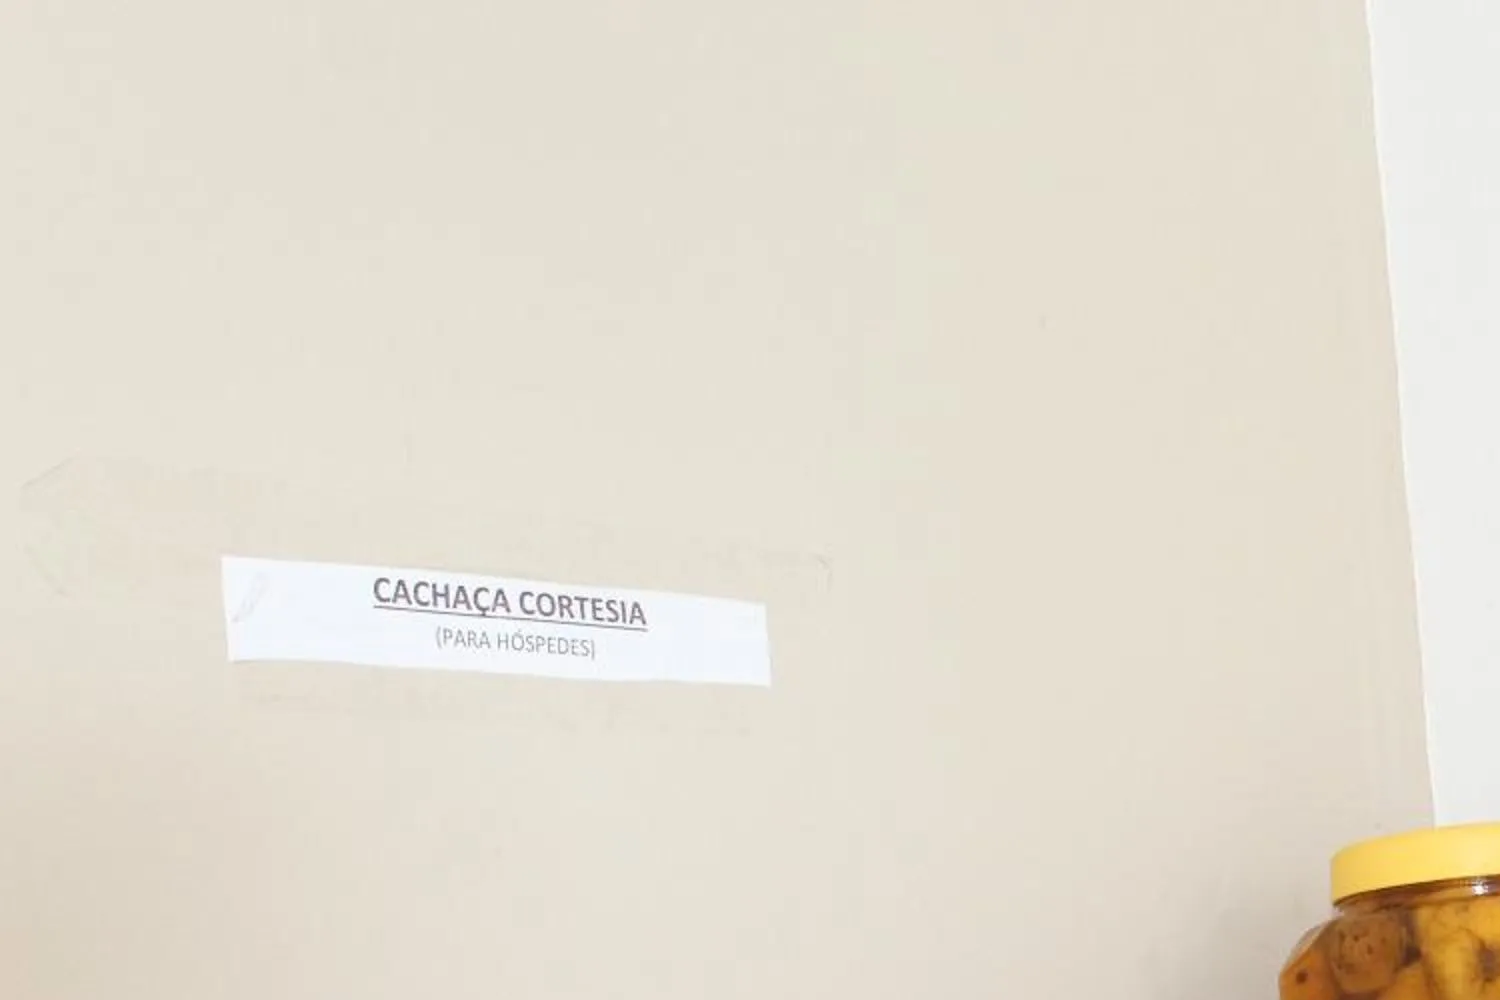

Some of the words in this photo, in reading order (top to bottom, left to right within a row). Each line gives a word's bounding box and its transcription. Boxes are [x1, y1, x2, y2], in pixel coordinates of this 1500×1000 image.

[373, 577, 511, 616] CACHAÇA
[519, 591, 647, 626] CORTESIA
[436, 627, 491, 651] (PARA
[497, 629, 596, 660] HÓSPEDES)
